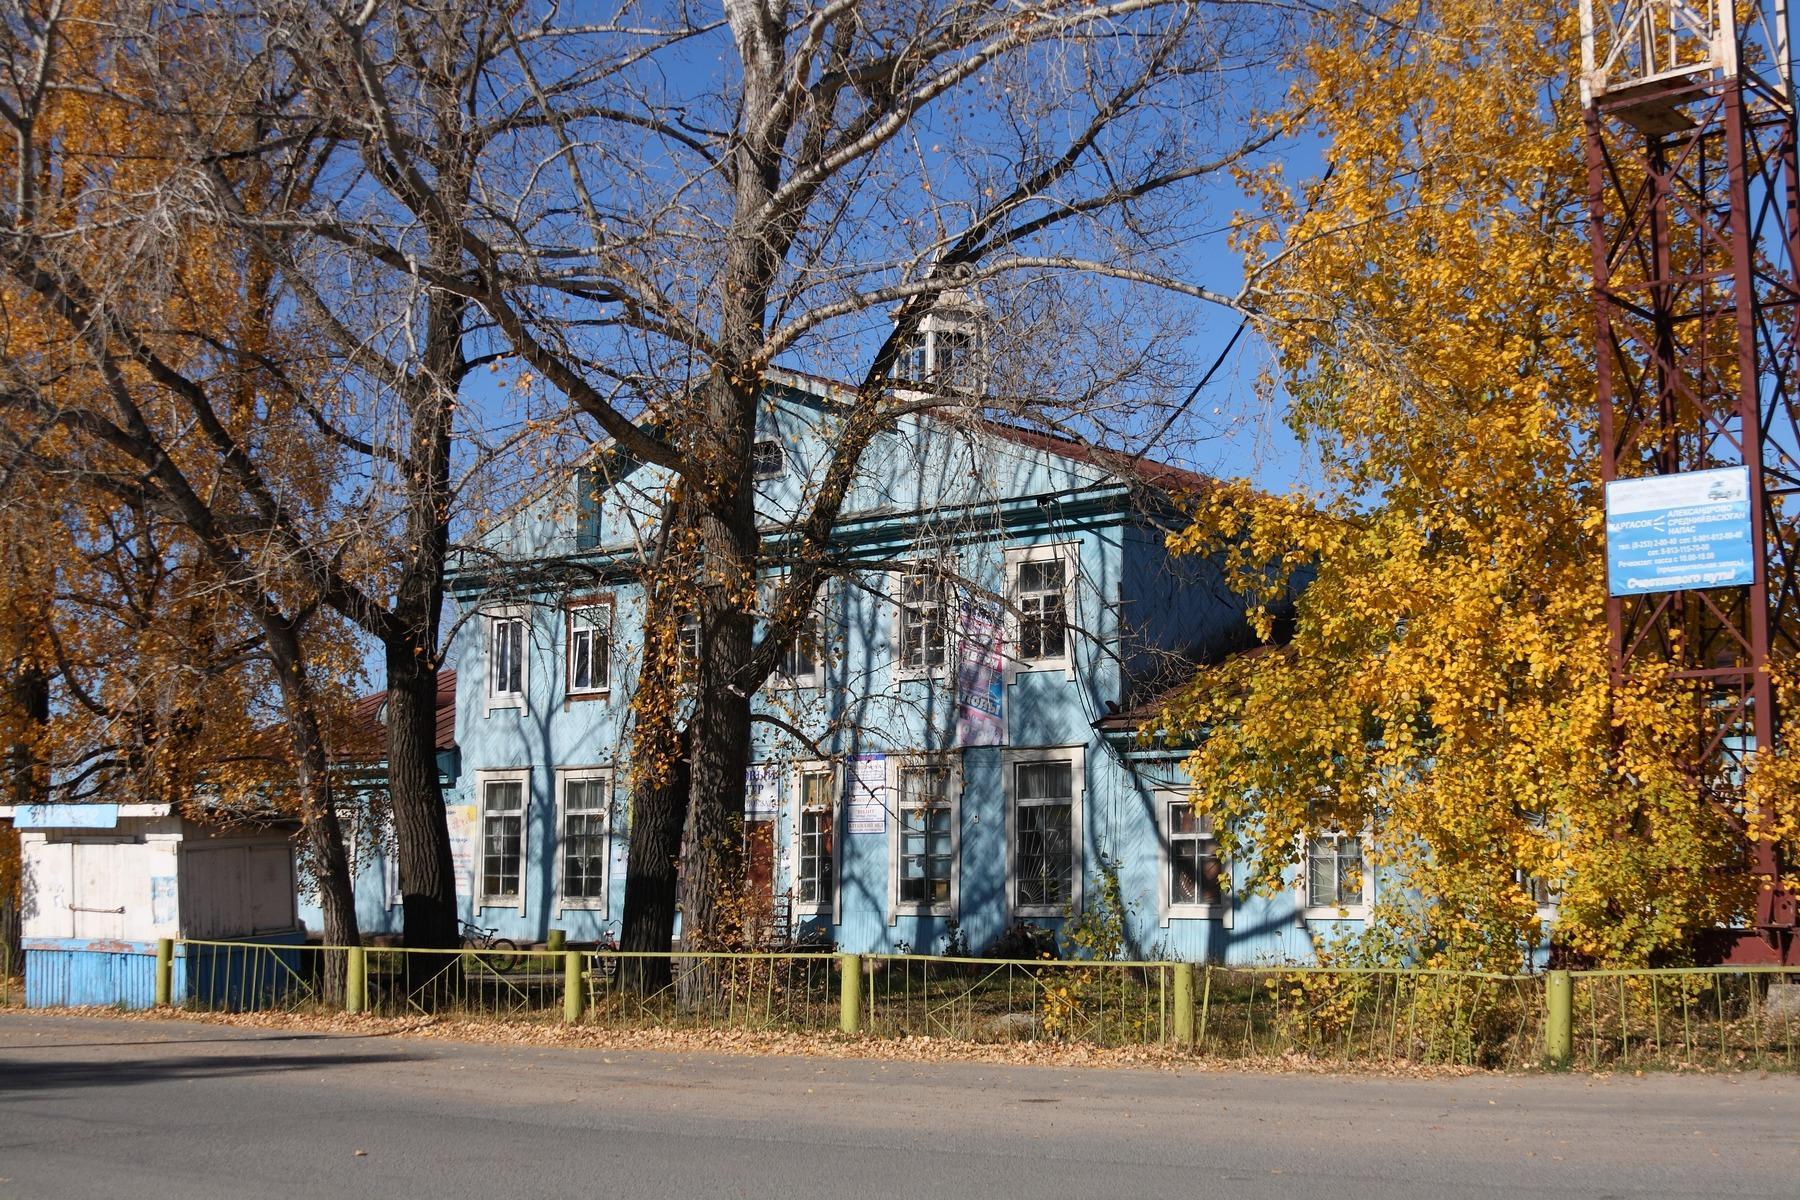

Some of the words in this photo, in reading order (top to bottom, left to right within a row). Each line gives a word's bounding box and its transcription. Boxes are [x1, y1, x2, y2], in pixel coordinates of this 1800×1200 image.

[1667, 504, 1733, 518] АЛЕКСАНДРОВО
[1667, 515, 1705, 526] СРЕДНИЙ
[1705, 512, 1745, 524] ВАСЮГАН
[1667, 526, 1696, 535] НАПАС
[1627, 573, 1702, 589] Счастливого
